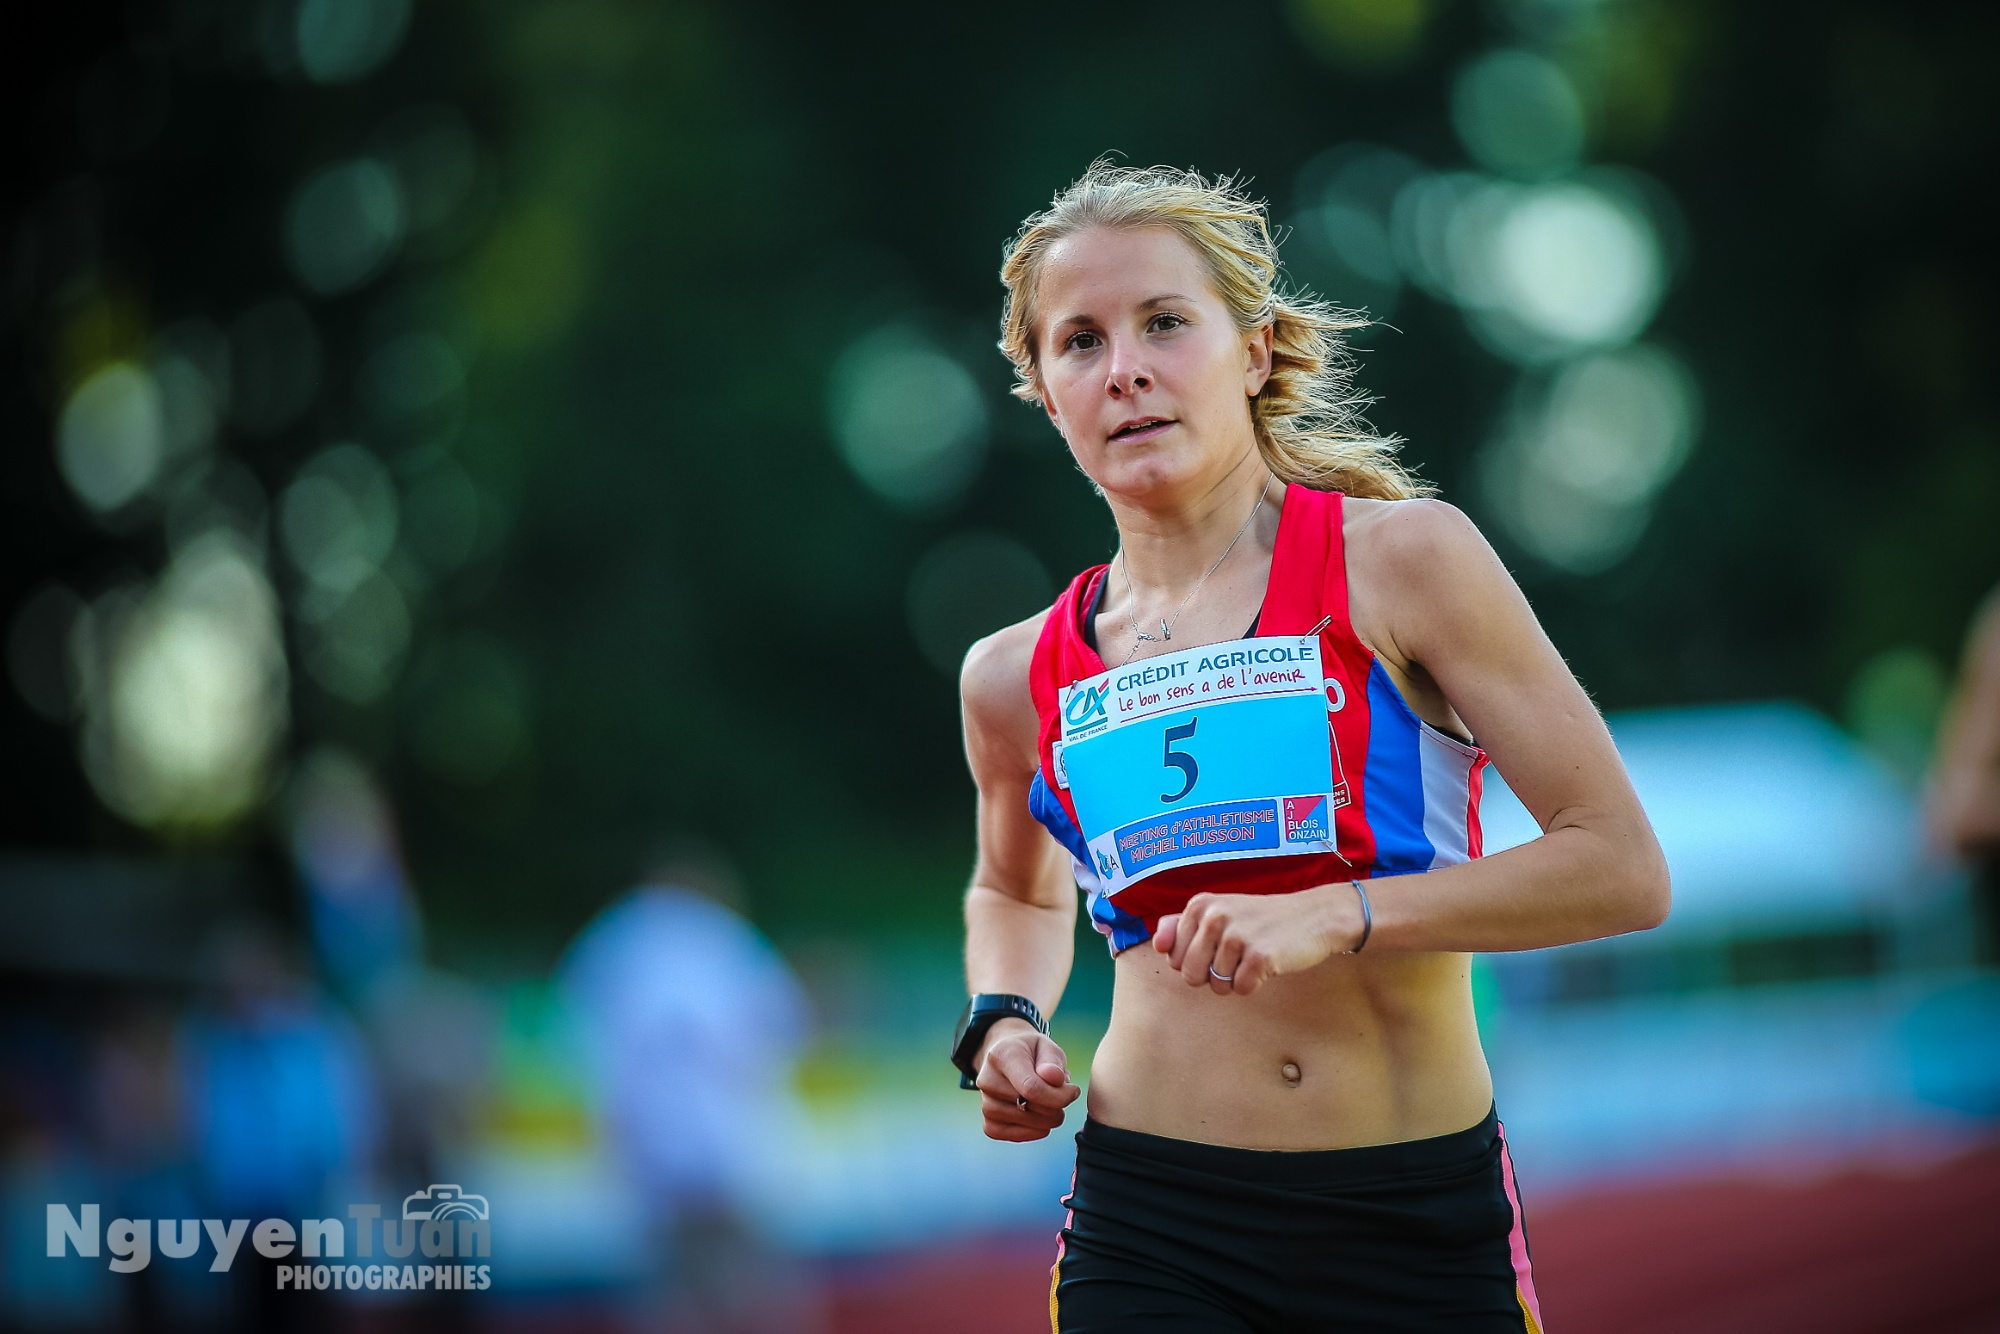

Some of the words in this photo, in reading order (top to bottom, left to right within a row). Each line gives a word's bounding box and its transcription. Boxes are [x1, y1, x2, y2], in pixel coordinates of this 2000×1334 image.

[1116, 660, 1190, 692] CRÉDIT
[1197, 647, 1315, 673] AGRICOLE
[1118, 697, 1134, 712] Le
[1138, 691, 1161, 707] bon
[1166, 682, 1195, 701] sens
[1201, 681, 1211, 692] a
[1217, 673, 1235, 690] de
[1088, 724, 1108, 736] FRANCE
[1159, 715, 1199, 804] 5
[1286, 800, 1295, 810] A
[1287, 810, 1294, 820] J
[1118, 824, 1169, 852] MEETING
[1171, 809, 1275, 834] d'ATHLETISME
[1287, 819, 1319, 830] BLOIS
[1288, 828, 1327, 840] ONZAIN
[1130, 837, 1180, 864] MICHEL
[1182, 826, 1256, 849] MUSSON
